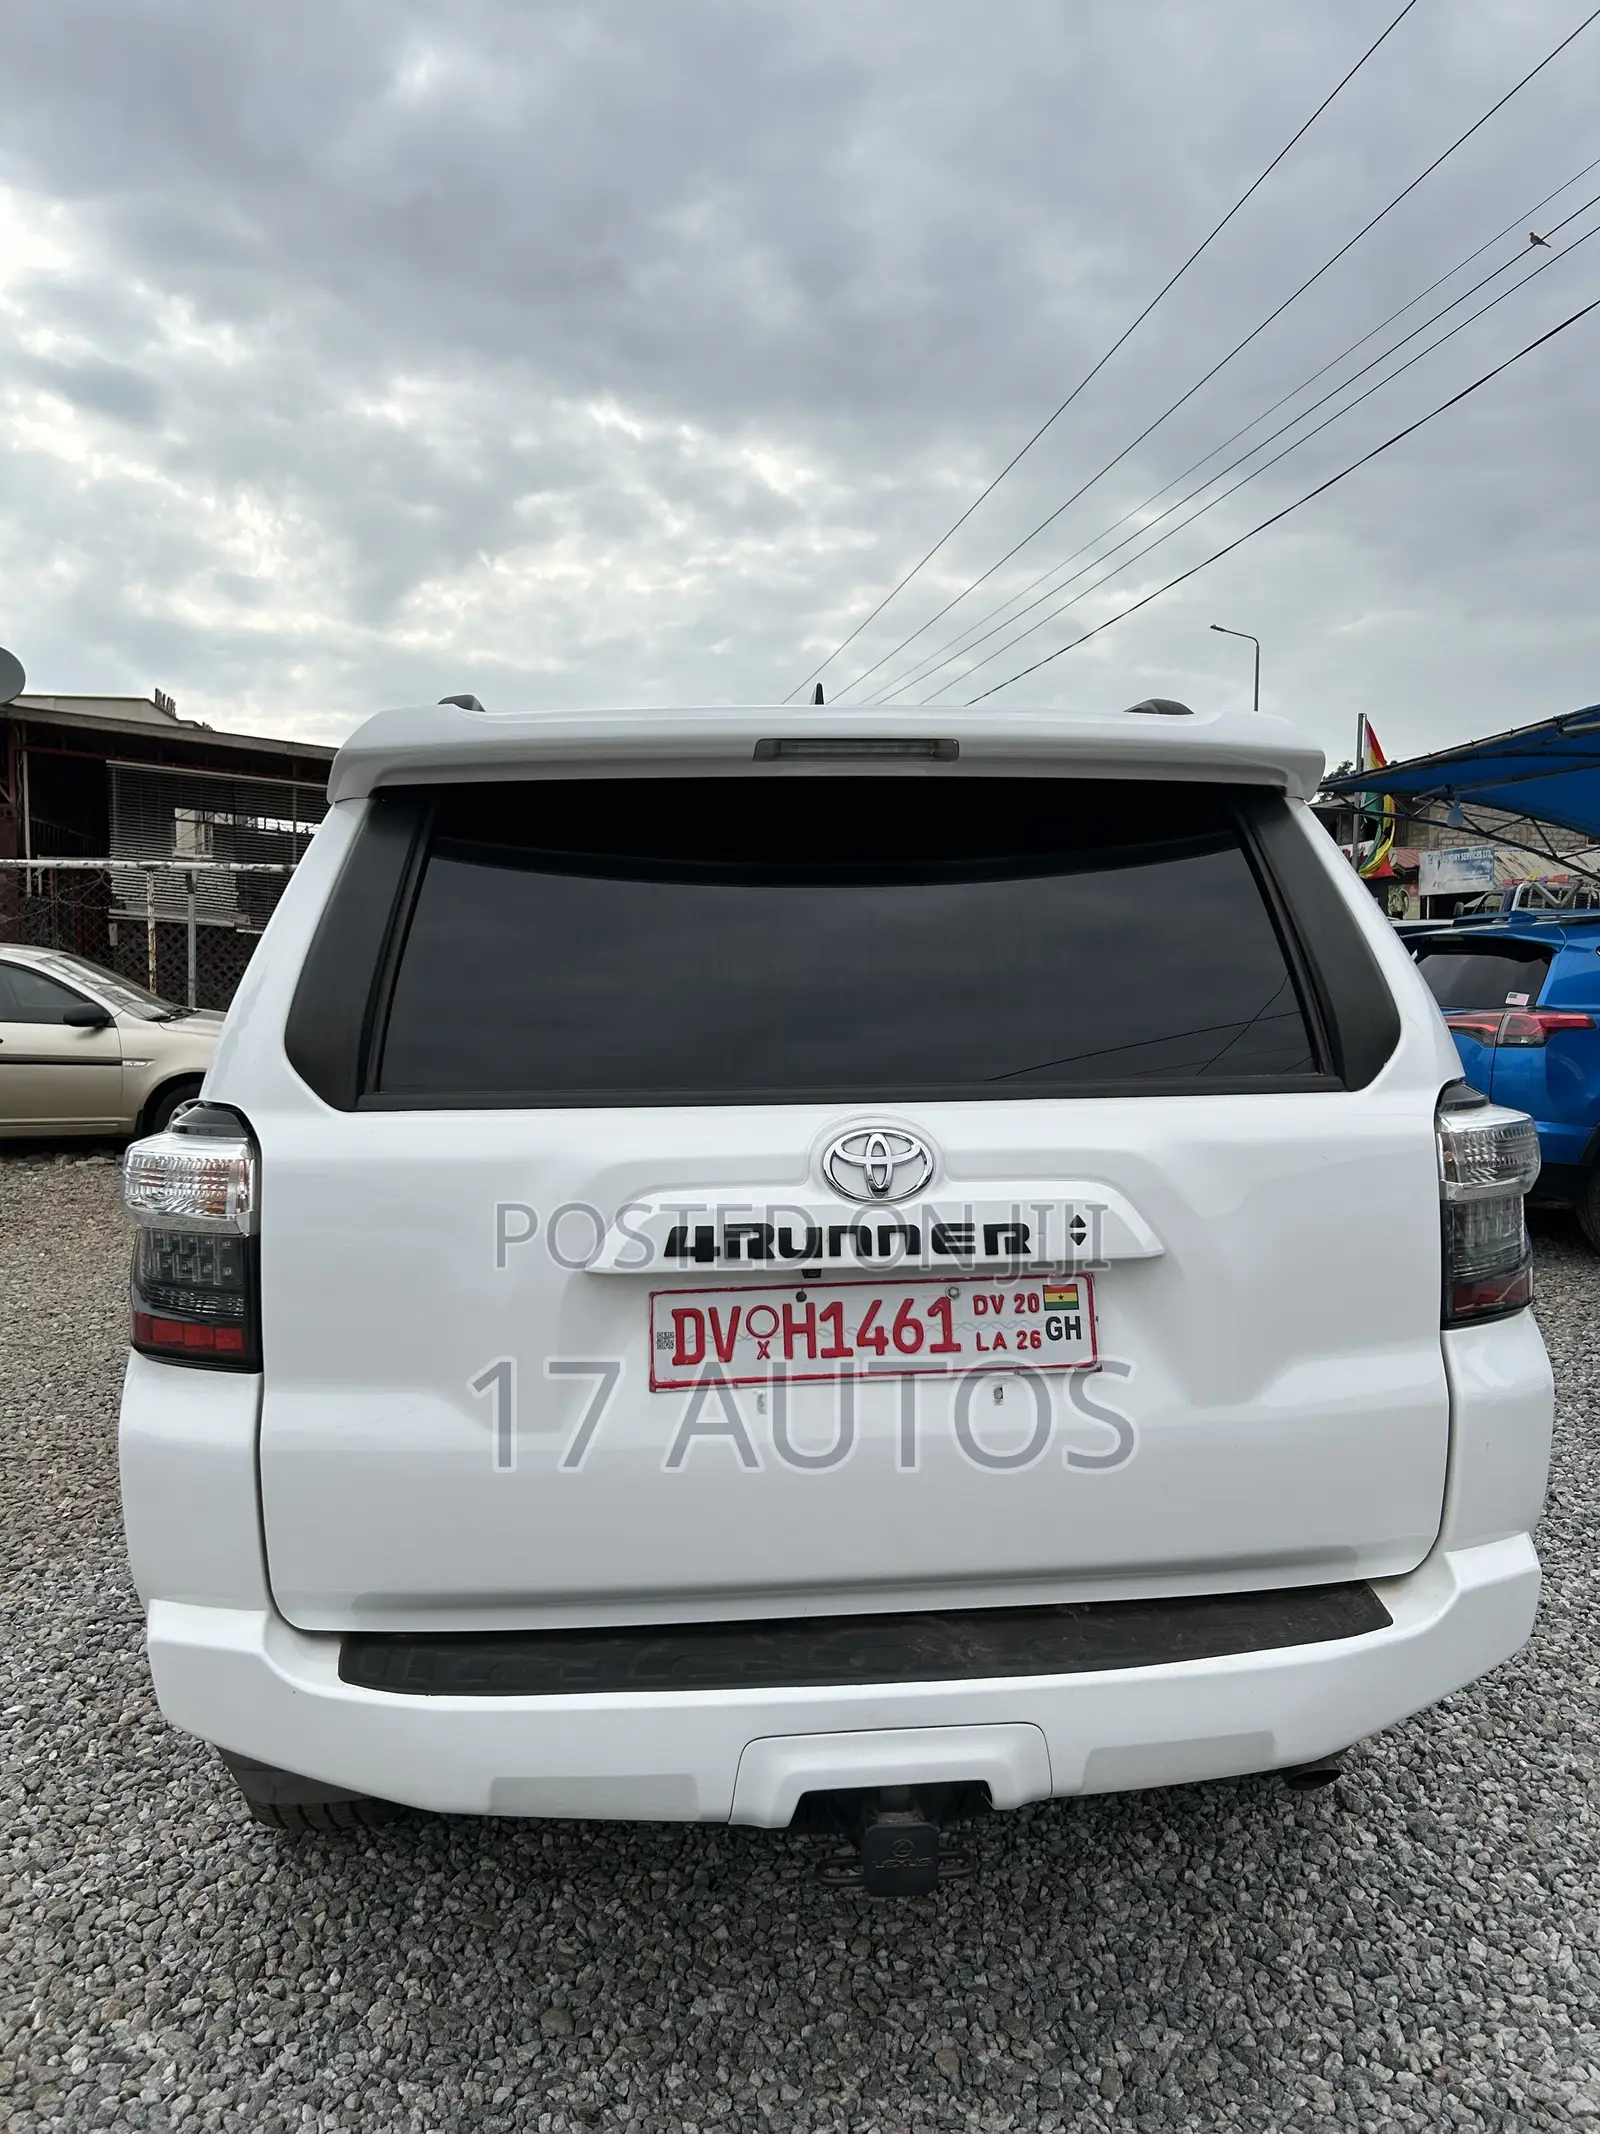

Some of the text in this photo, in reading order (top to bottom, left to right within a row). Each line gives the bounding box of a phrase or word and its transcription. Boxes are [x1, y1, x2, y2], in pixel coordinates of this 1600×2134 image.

[973, 1292, 1040, 1316] DV 20
[783, 1297, 962, 1360] H1461
[976, 1329, 1043, 1352] LA 26
[1044, 1315, 1082, 1342] GH
